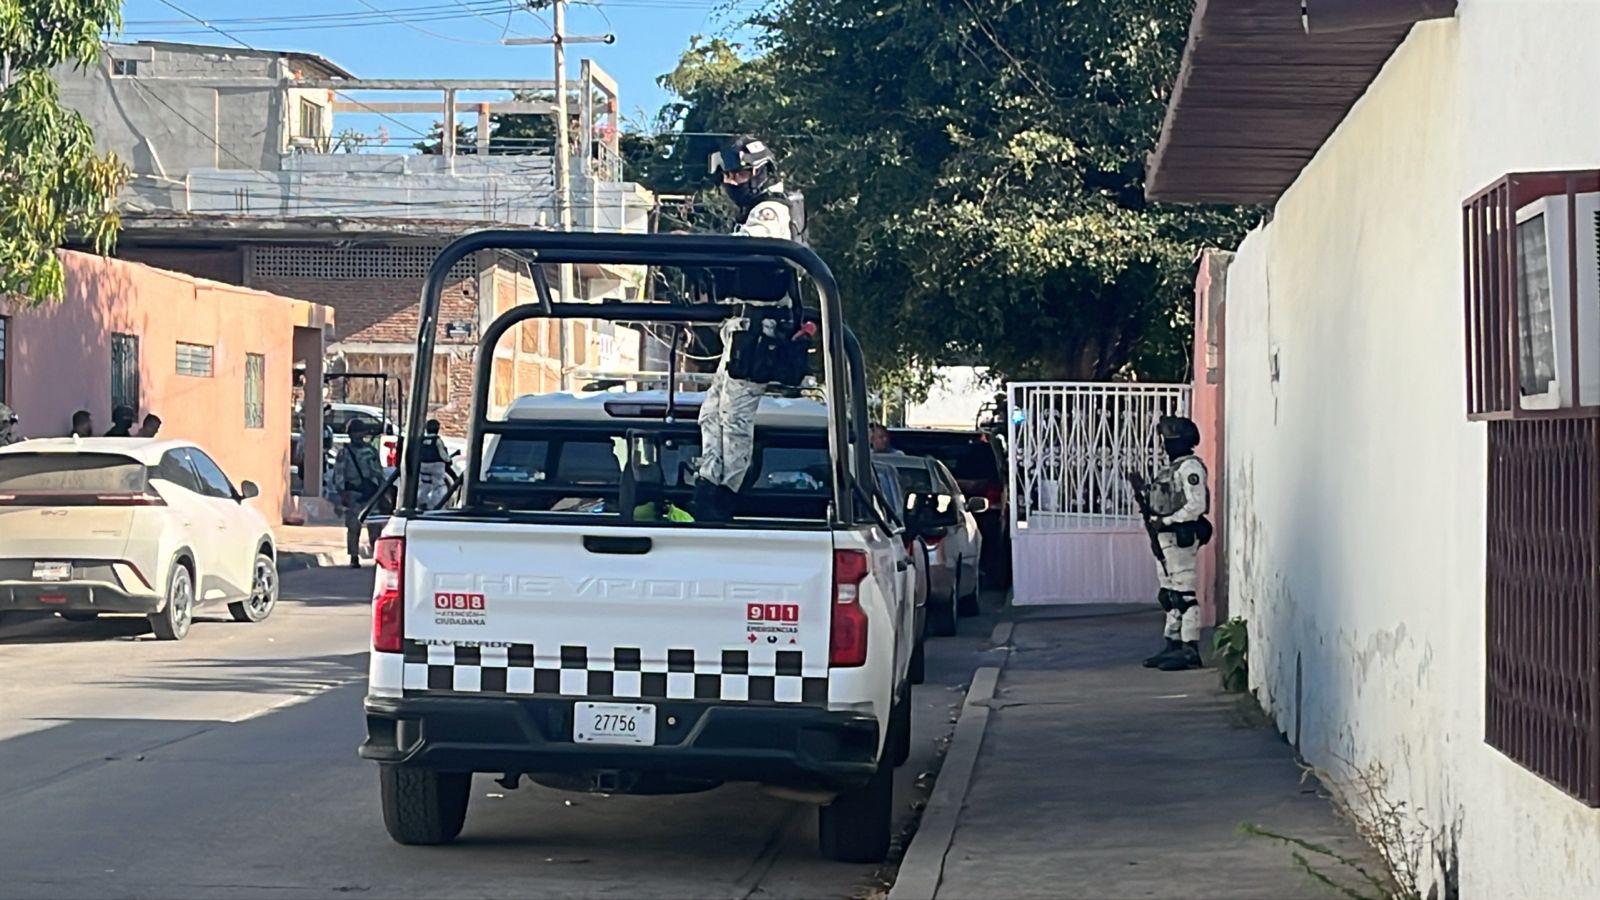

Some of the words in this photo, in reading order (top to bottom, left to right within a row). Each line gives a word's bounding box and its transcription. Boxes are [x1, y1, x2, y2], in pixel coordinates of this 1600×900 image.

[437, 594, 483, 609] 088
[750, 605, 795, 620] 911
[594, 714, 636, 732] 27756
